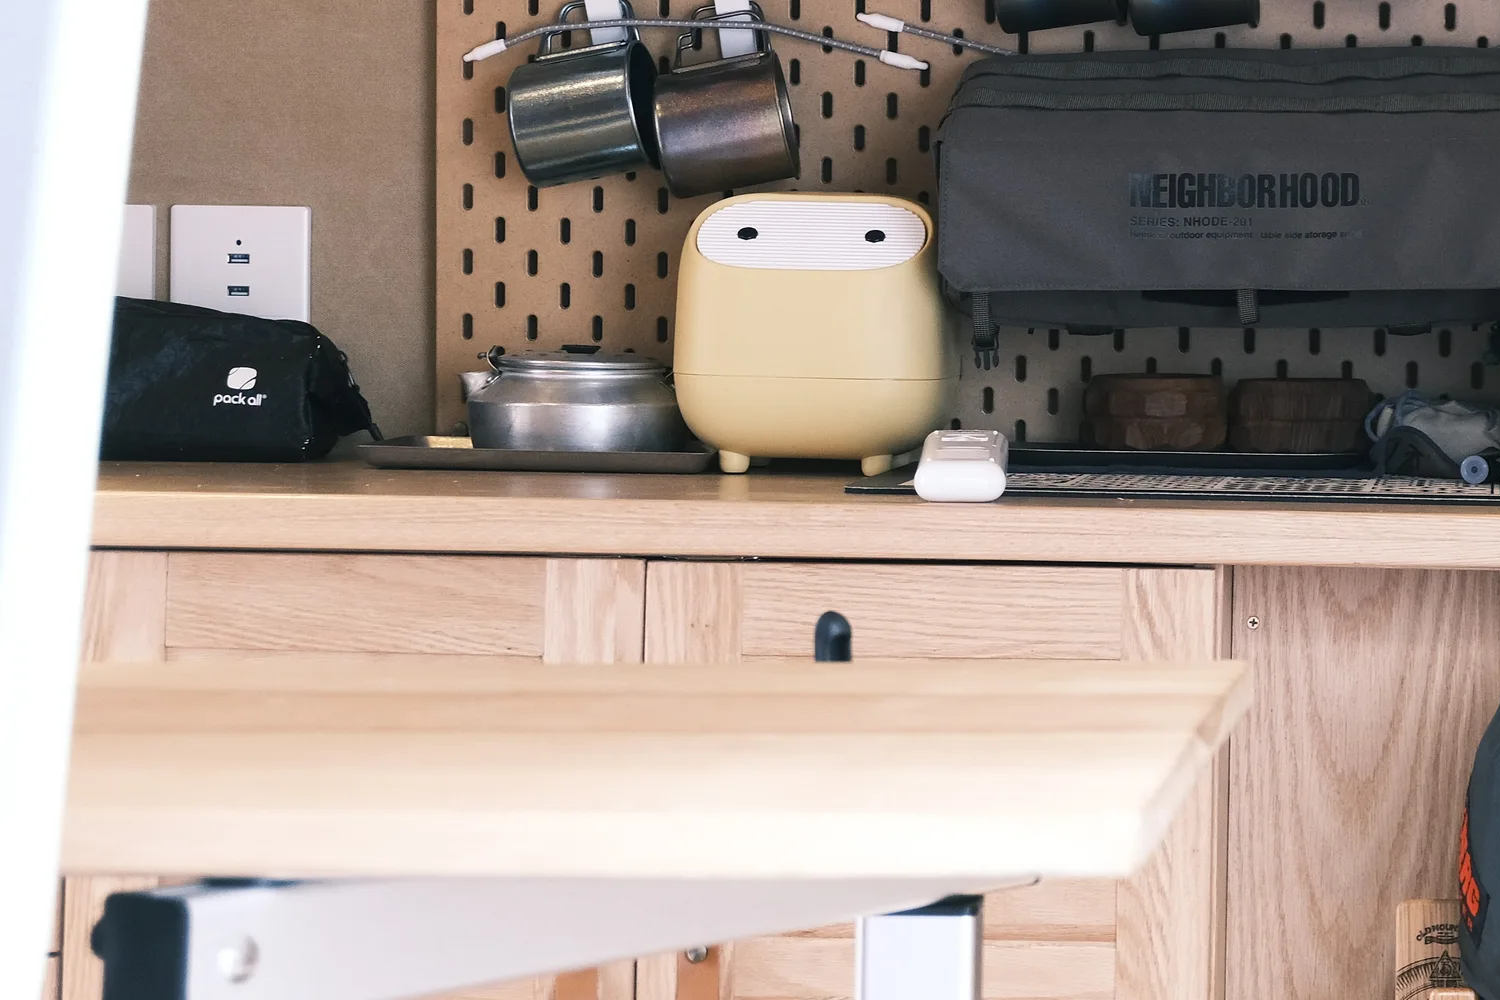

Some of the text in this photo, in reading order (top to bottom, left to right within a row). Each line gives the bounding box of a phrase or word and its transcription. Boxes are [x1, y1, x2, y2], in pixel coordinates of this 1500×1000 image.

[1128, 172, 1360, 209] NEIGHBORHOOD
[1129, 216, 1180, 227] SERIES:
[1169, 231, 1204, 239] outdoor
[1206, 231, 1253, 240] equipment
[1261, 231, 1282, 239] table
[213, 392, 246, 406] pack
[1416, 926, 1432, 942] OLD
